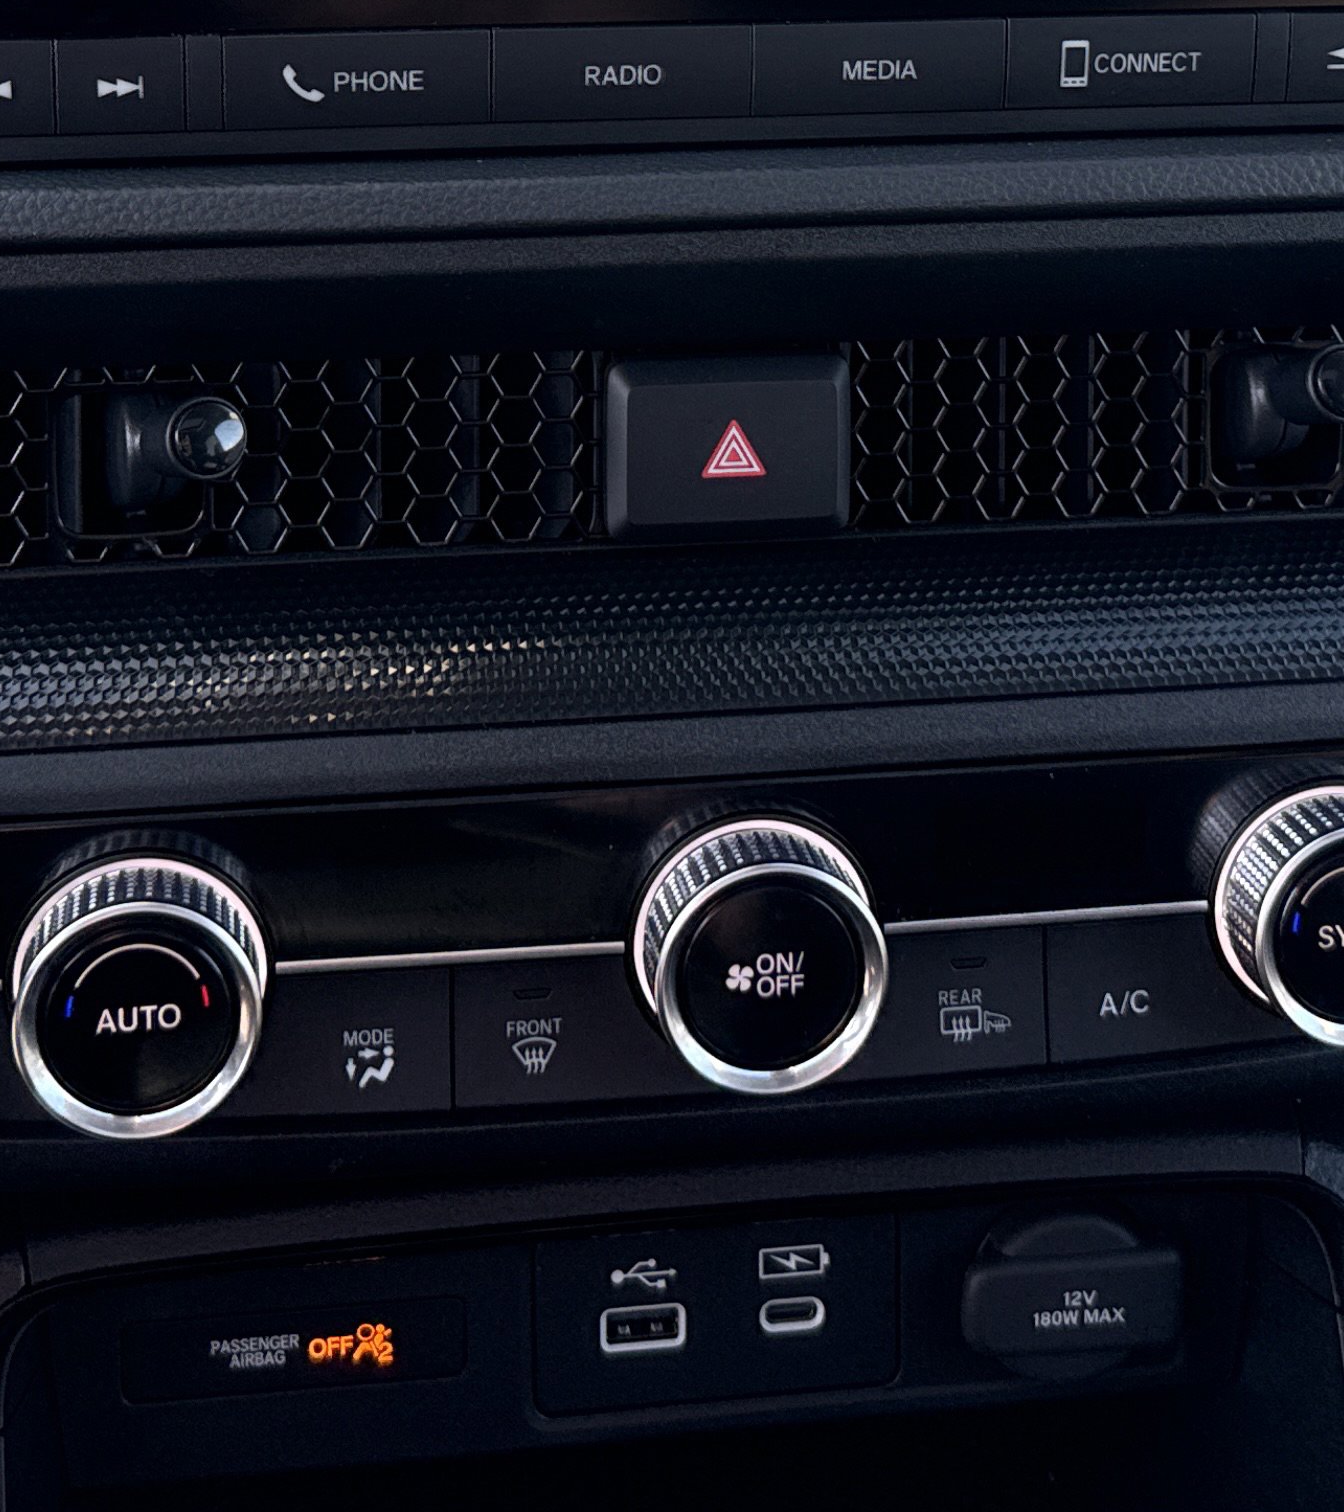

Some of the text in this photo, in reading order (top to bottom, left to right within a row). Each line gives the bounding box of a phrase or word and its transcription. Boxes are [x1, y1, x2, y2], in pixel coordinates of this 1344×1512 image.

[842, 59, 917, 81] MEDIA
[1094, 51, 1202, 74] CONNECT
[333, 69, 424, 92] PHONE
[584, 64, 662, 86] RADIO
[756, 952, 804, 973] ON/
[756, 973, 805, 998] OFF
[938, 989, 982, 1004] REAR
[1099, 989, 1149, 1016] A/C
[96, 1003, 182, 1034] AUTO
[506, 1017, 562, 1036] FRONT
[343, 1028, 394, 1046] MODE
[1064, 1290, 1097, 1307] 12V
[1034, 1306, 1125, 1328] 180W MAX
[210, 1333, 300, 1356] PASSENGER
[308, 1334, 354, 1362] OFF
[229, 1349, 286, 1368] AIRBAG
